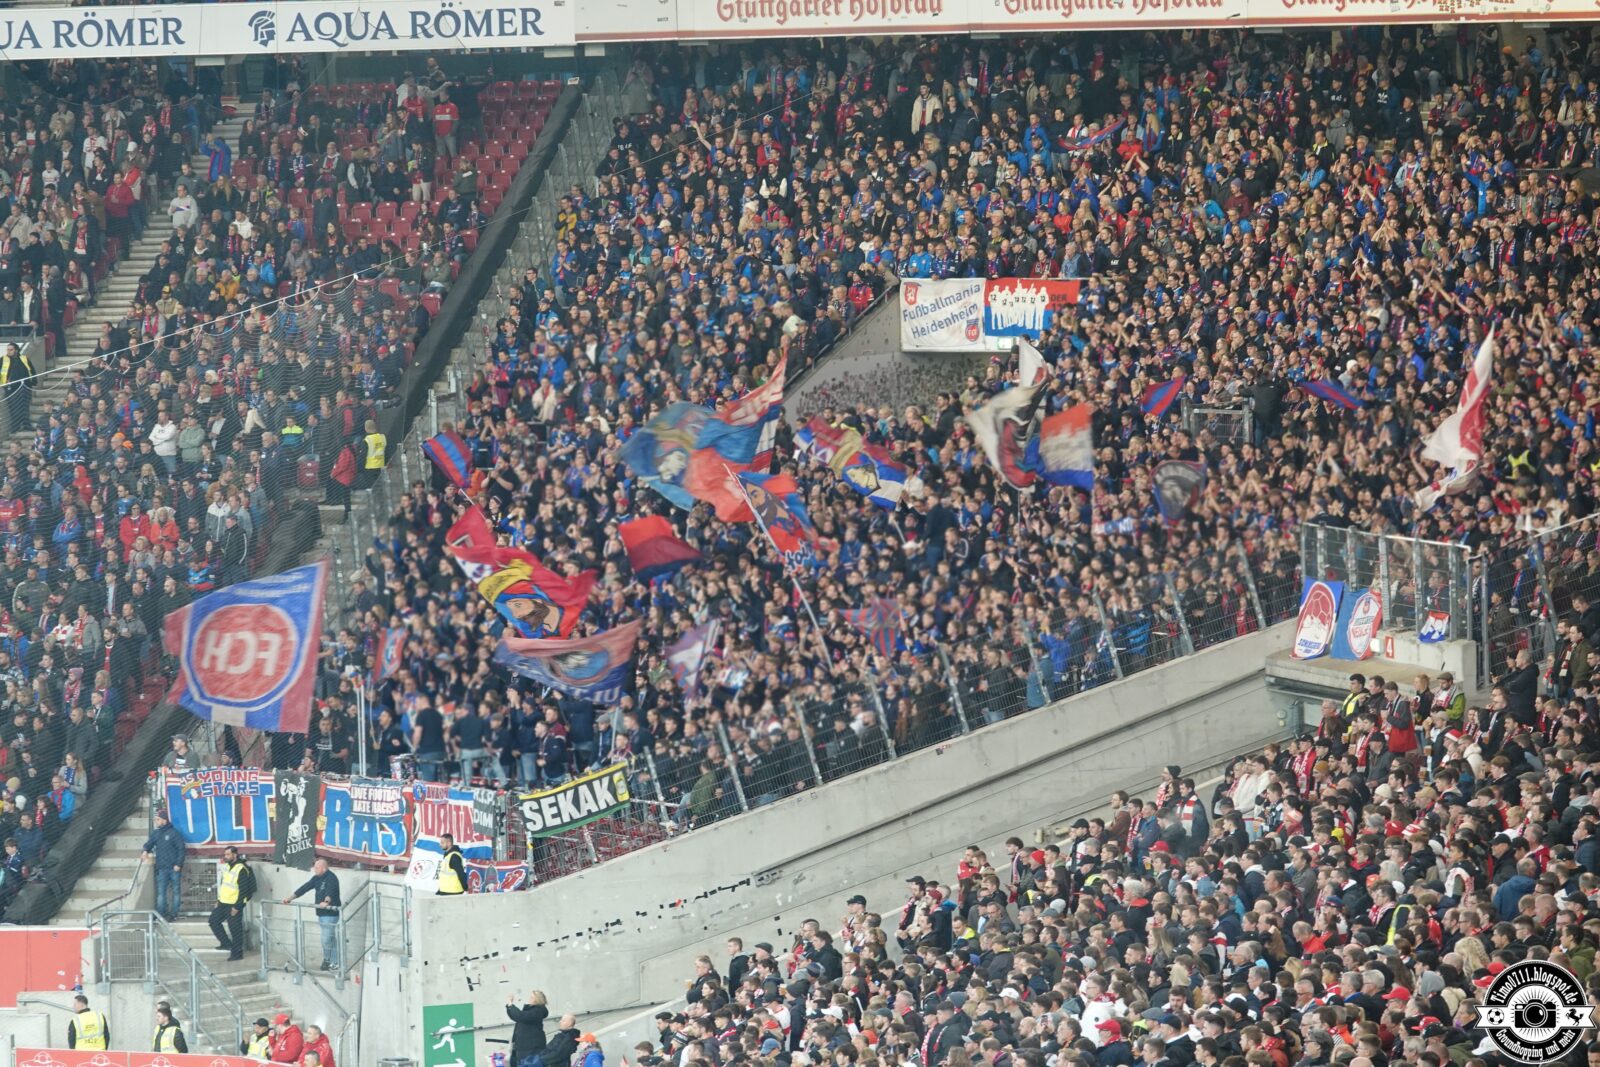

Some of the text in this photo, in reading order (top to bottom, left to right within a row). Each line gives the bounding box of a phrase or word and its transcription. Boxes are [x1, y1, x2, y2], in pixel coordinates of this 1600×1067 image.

[52, 12, 186, 49] RÖMER
[285, 2, 544, 47] AQUA RÖMER
[903, 283, 981, 322] Fußballmania
[911, 303, 979, 339] Heidenheim
[1387, 638, 1393, 657] 4
[197, 770, 259, 783] YOUNG
[200, 781, 260, 798] STARS
[523, 775, 617, 832] SEKAK
